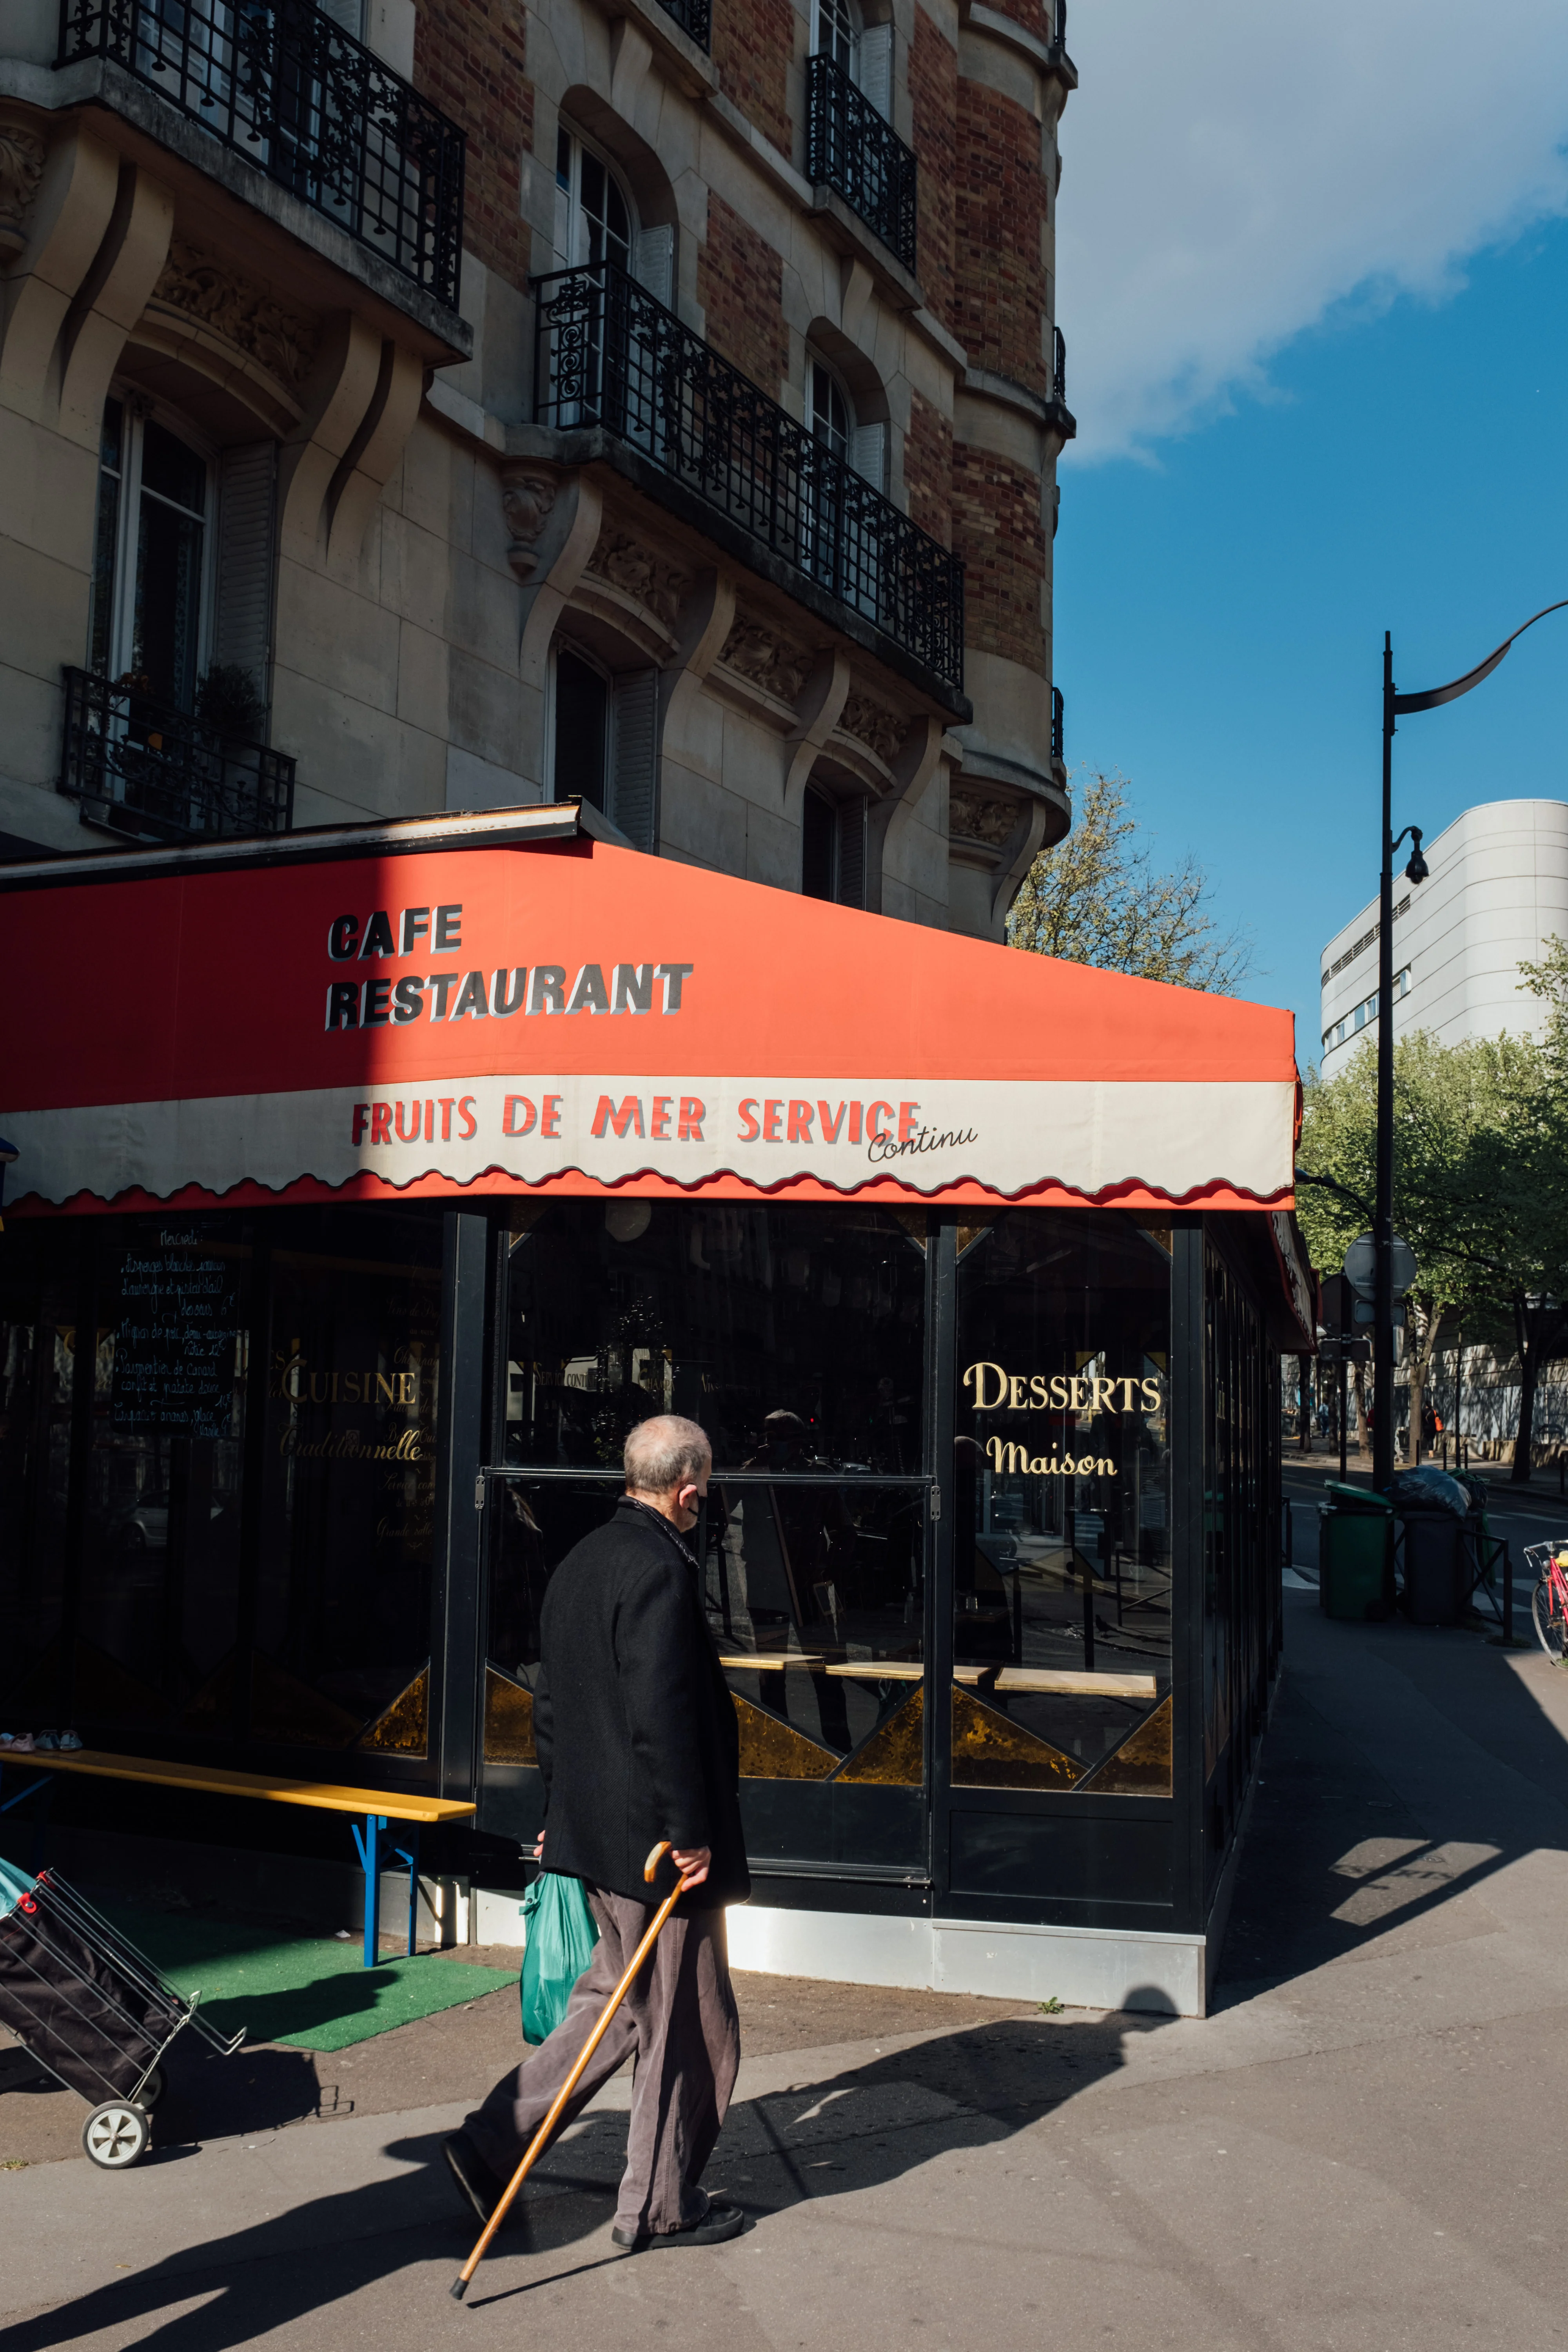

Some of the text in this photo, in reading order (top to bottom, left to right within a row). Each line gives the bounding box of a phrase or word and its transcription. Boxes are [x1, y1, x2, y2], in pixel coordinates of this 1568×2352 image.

[328, 904, 463, 962] CAFE
[325, 964, 694, 1032] RESTAURANT
[352, 1094, 921, 1147] FRUITS DE MER SERVICE
[867, 1126, 979, 1163] Continu
[152, 1323, 162, 1338] de
[121, 1374, 147, 1402] confit
[149, 1377, 157, 1392] et
[163, 1378, 196, 1401] patate
[198, 1380, 220, 1394] douce
[174, 1359, 183, 1375] de
[187, 1361, 218, 1377] Canard
[281, 1358, 416, 1404] CUISINE
[963, 1362, 1163, 1414] DESSERTS
[278, 1422, 423, 1461] Traditionnelle
[986, 1436, 1118, 1476] Maison
